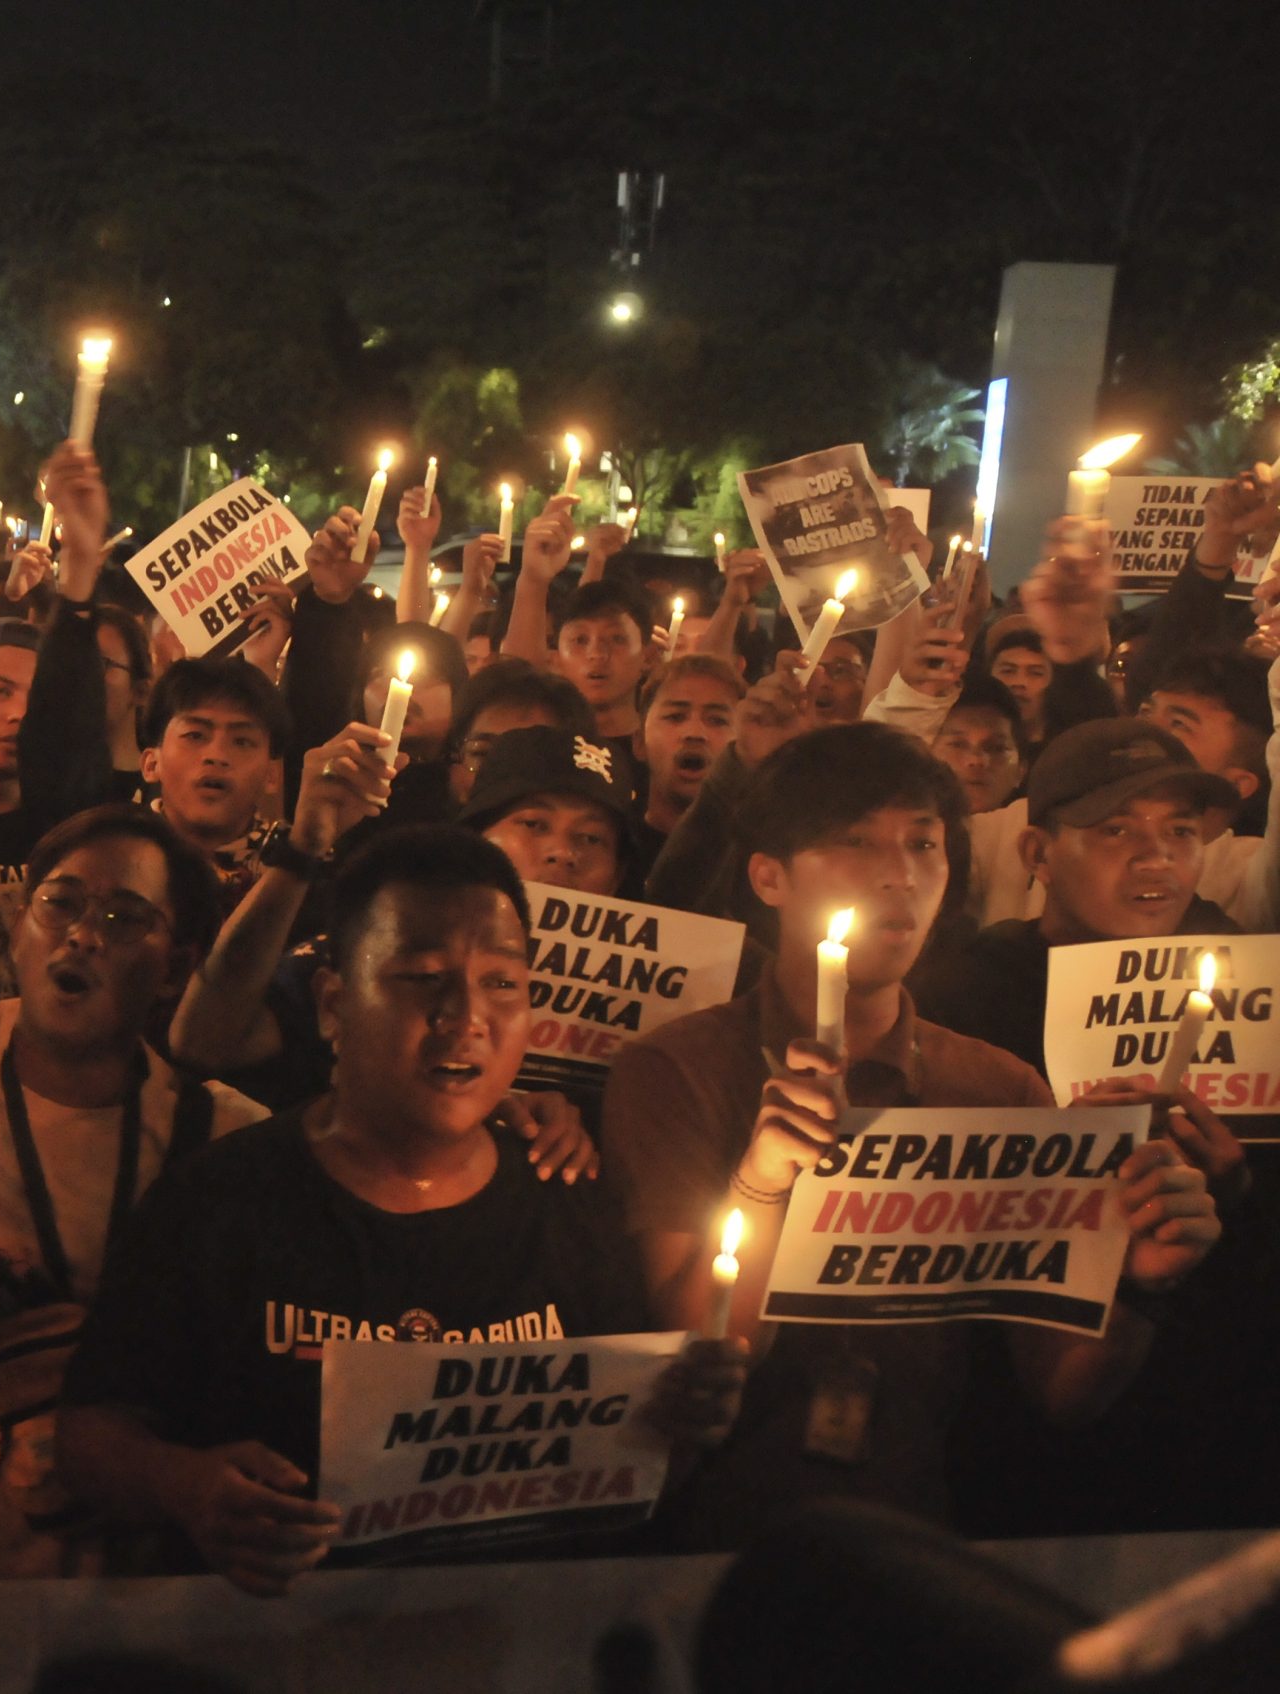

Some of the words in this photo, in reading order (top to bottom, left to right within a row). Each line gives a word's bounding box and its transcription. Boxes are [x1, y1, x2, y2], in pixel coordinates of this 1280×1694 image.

[806, 466, 854, 498] COPS
[1142, 485, 1198, 504] TIDAK
[799, 502, 836, 528] ARE
[1134, 508, 1205, 527] SEPAKB
[145, 489, 273, 592] SEPAKBOLA
[1108, 530, 1155, 549] YANG
[1111, 553, 1183, 571] DENGAN
[170, 512, 292, 617] INDONESIA
[537, 897, 658, 952] DUKA
[529, 980, 642, 1031] DUKA
[1112, 1030, 1235, 1067] DUA
[813, 1133, 1134, 1180] SEPAKBOLA
[812, 1188, 1107, 1234] INDONESIA
[817, 1240, 1069, 1285] BERDUKA
[432, 1353, 591, 1400] DUKA
[384, 1395, 629, 1450] MALANG
[420, 1436, 570, 1484] DUKA
[341, 1466, 635, 1540] INDONESIA
